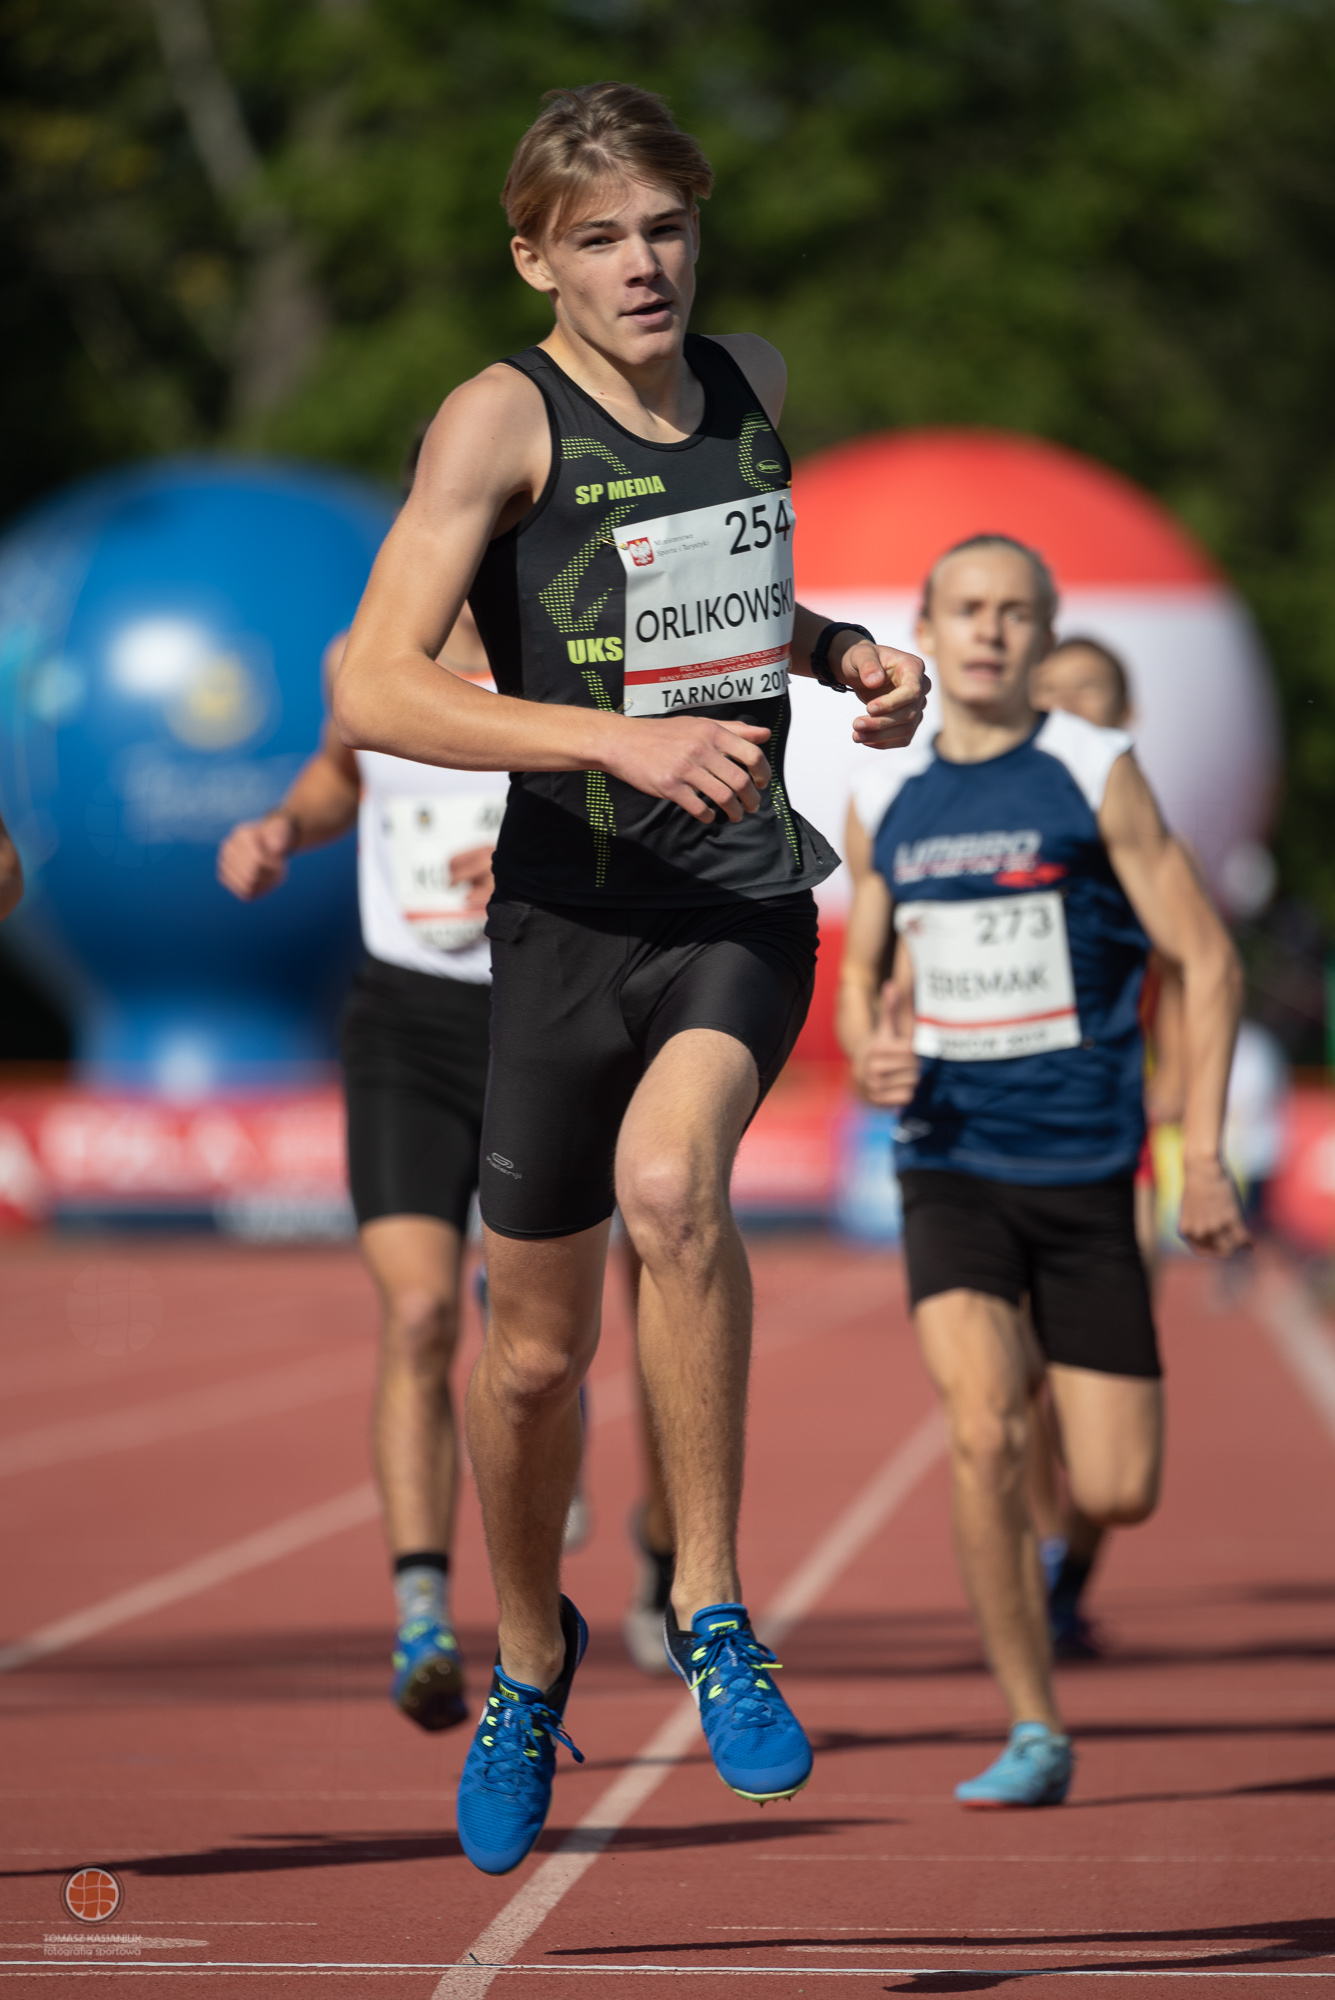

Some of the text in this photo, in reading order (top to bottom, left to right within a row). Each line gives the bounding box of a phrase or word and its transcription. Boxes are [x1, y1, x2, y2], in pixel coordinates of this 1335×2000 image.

[575, 475, 666, 505] SP MEDIA
[725, 500, 791, 555] 254
[636, 577, 794, 643] ORLIKOWSKI
[567, 637, 623, 664] UKS
[662, 675, 754, 708] TARNÓW
[976, 904, 1053, 944] 273
